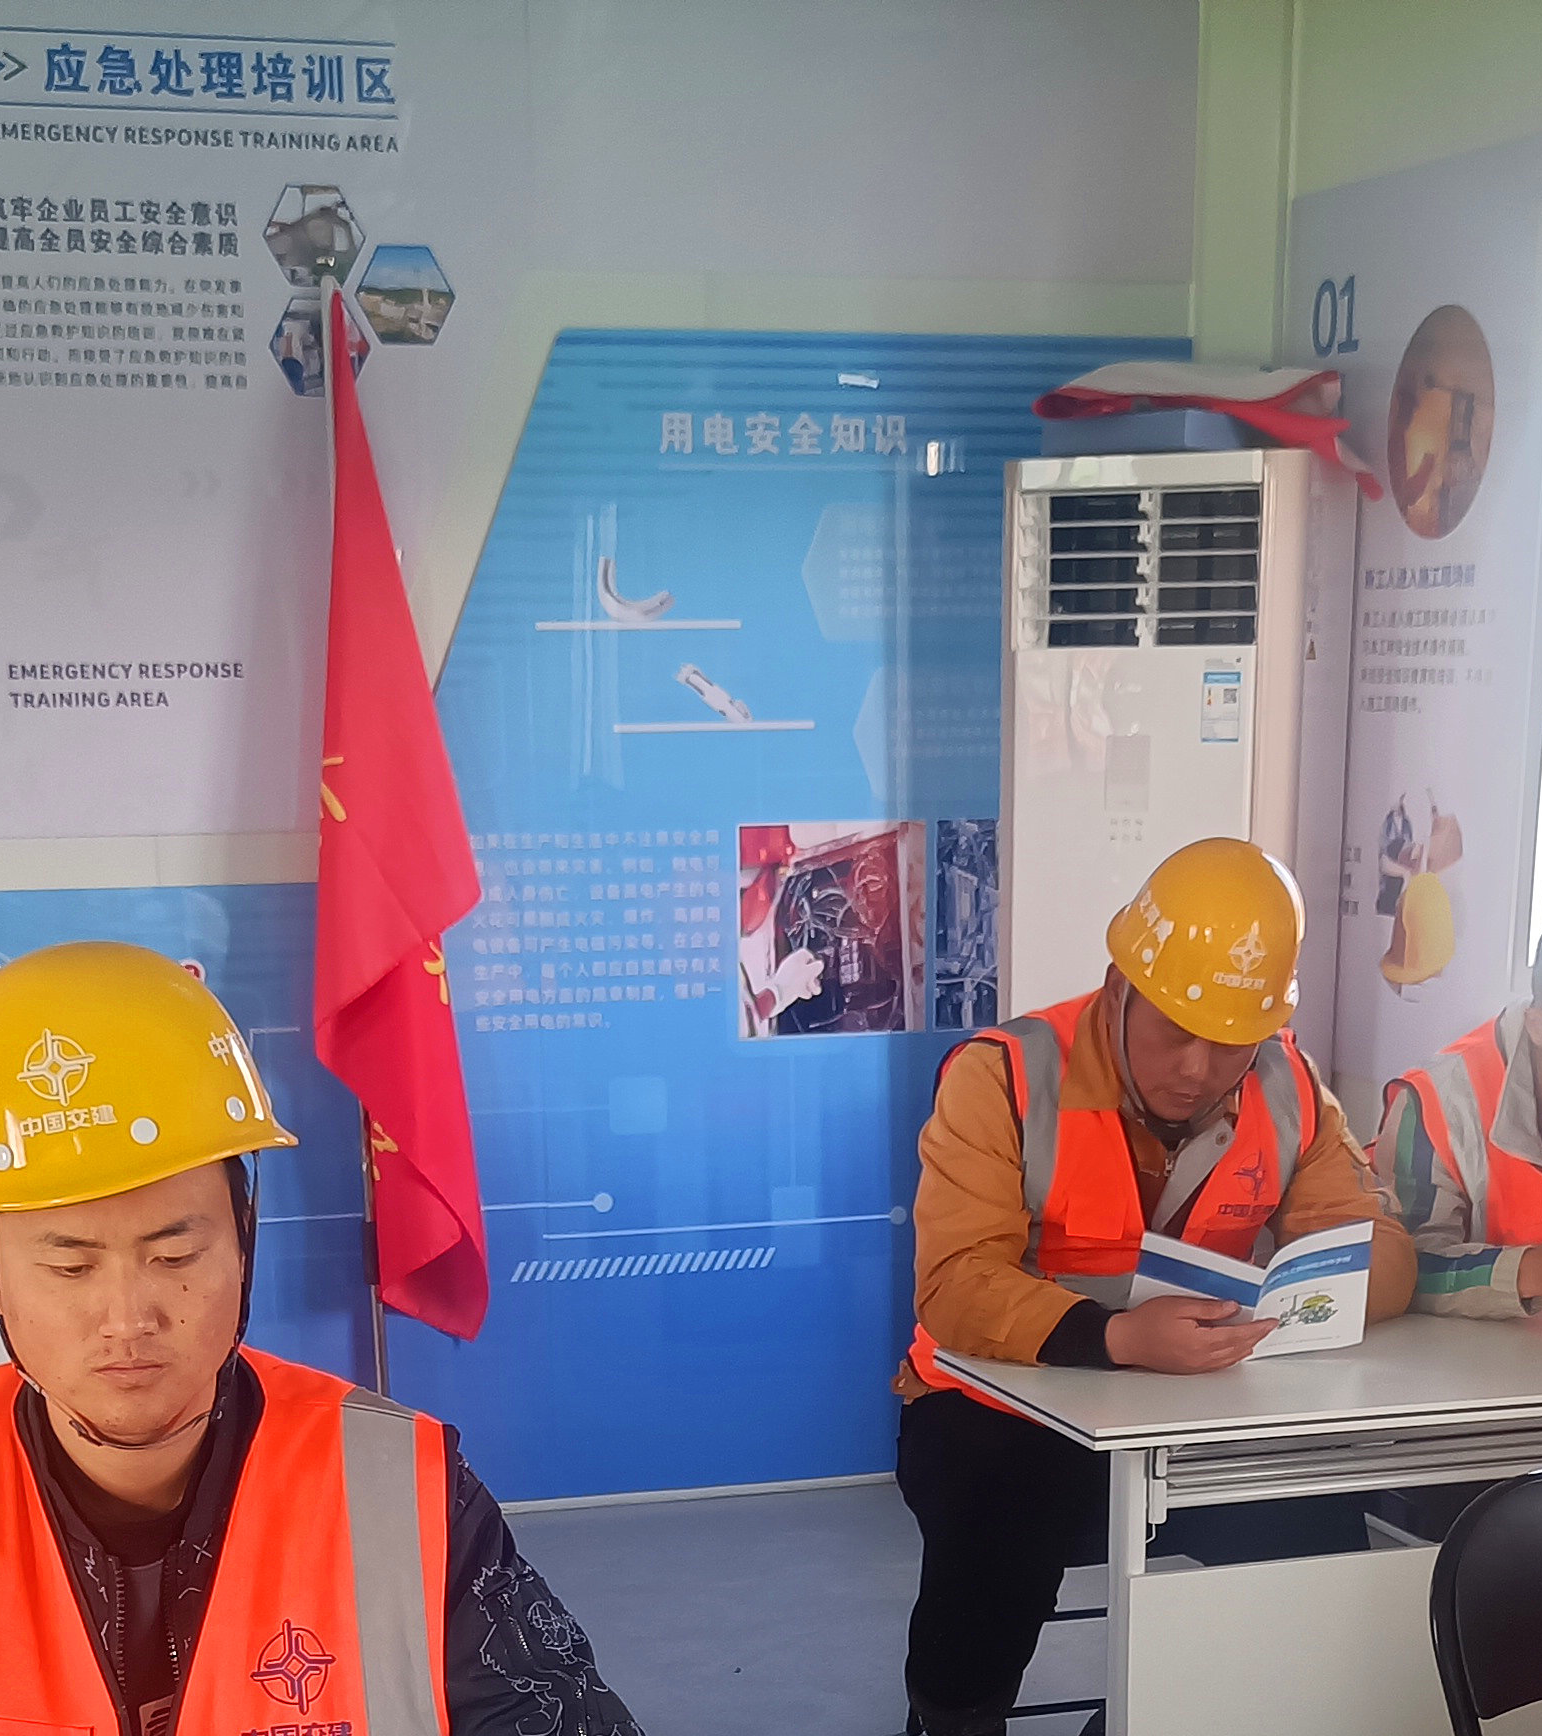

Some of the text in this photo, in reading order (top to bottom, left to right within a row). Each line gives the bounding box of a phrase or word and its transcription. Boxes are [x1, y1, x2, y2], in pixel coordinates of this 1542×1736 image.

[44, 42, 396, 104] 应急处理培训区
[124, 125, 234, 149] RESPONSE
[241, 130, 340, 152] TRAINING
[346, 134, 399, 153] AREA
[1312, 274, 1360, 359] 01
[659, 412, 908, 456] 用电安全知识
[7, 661, 244, 681] EMERGENCY RESPONSE
[9, 690, 170, 710] TRAINING AREA
[19, 1104, 118, 1138] 中国交建
